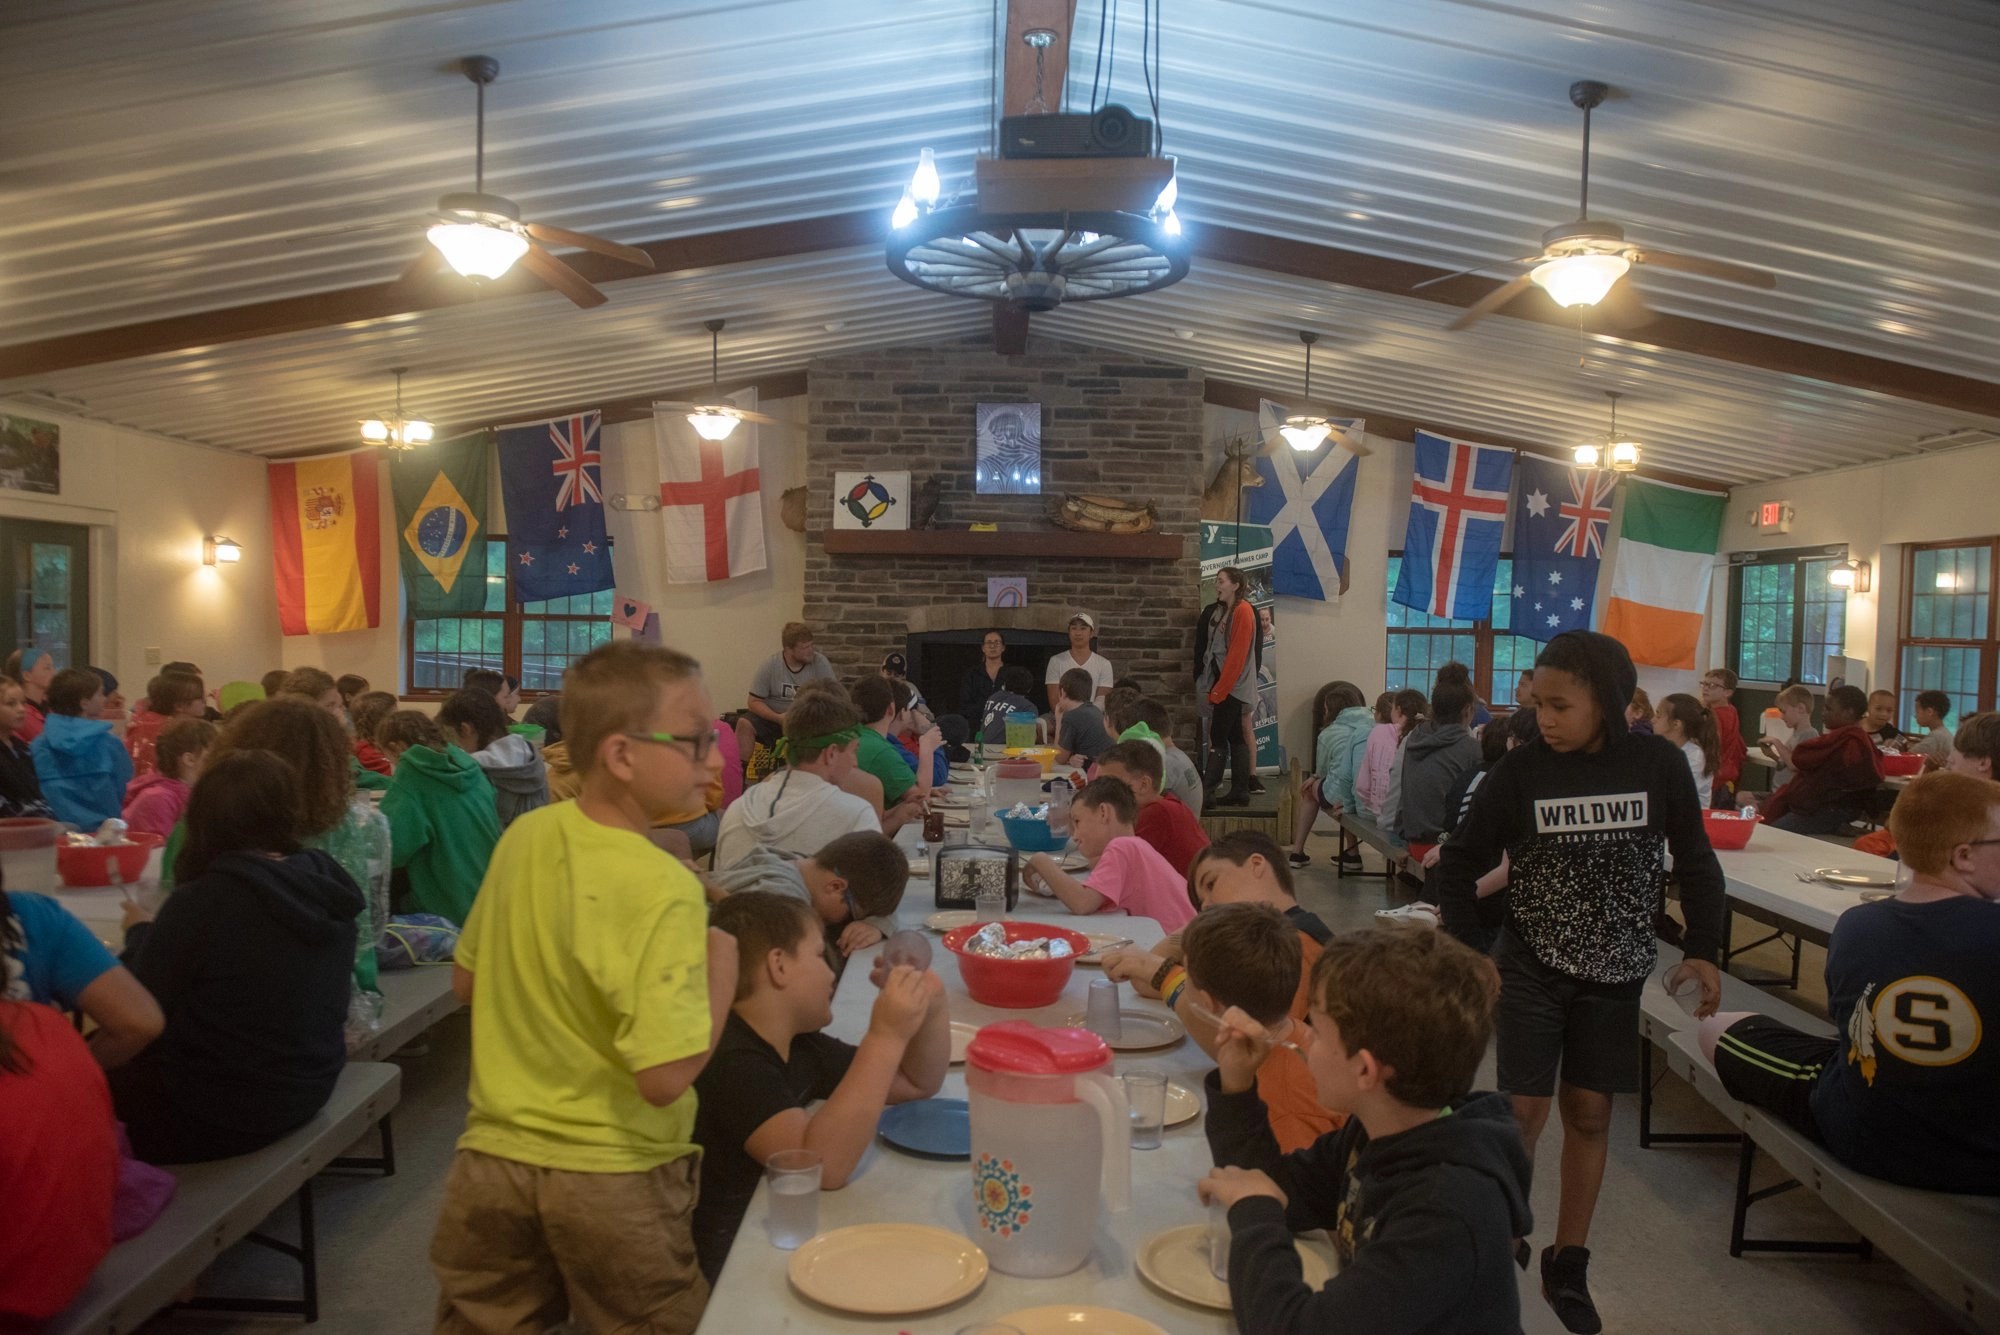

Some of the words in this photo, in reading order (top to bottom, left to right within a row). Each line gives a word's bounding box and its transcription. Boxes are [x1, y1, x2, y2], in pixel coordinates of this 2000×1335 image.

[1762, 503, 1780, 526] EXIT
[1207, 525, 1220, 544] Y
[1201, 560, 1232, 572] OVERNIGHT
[1255, 552, 1269, 561] CAMP
[1254, 715, 1277, 728] RESPECT
[1540, 799, 1644, 828] WRLDWD
[1557, 833, 1587, 844] STAY
[1594, 831, 1631, 842] CHILL
[1894, 991, 1952, 1052] S
